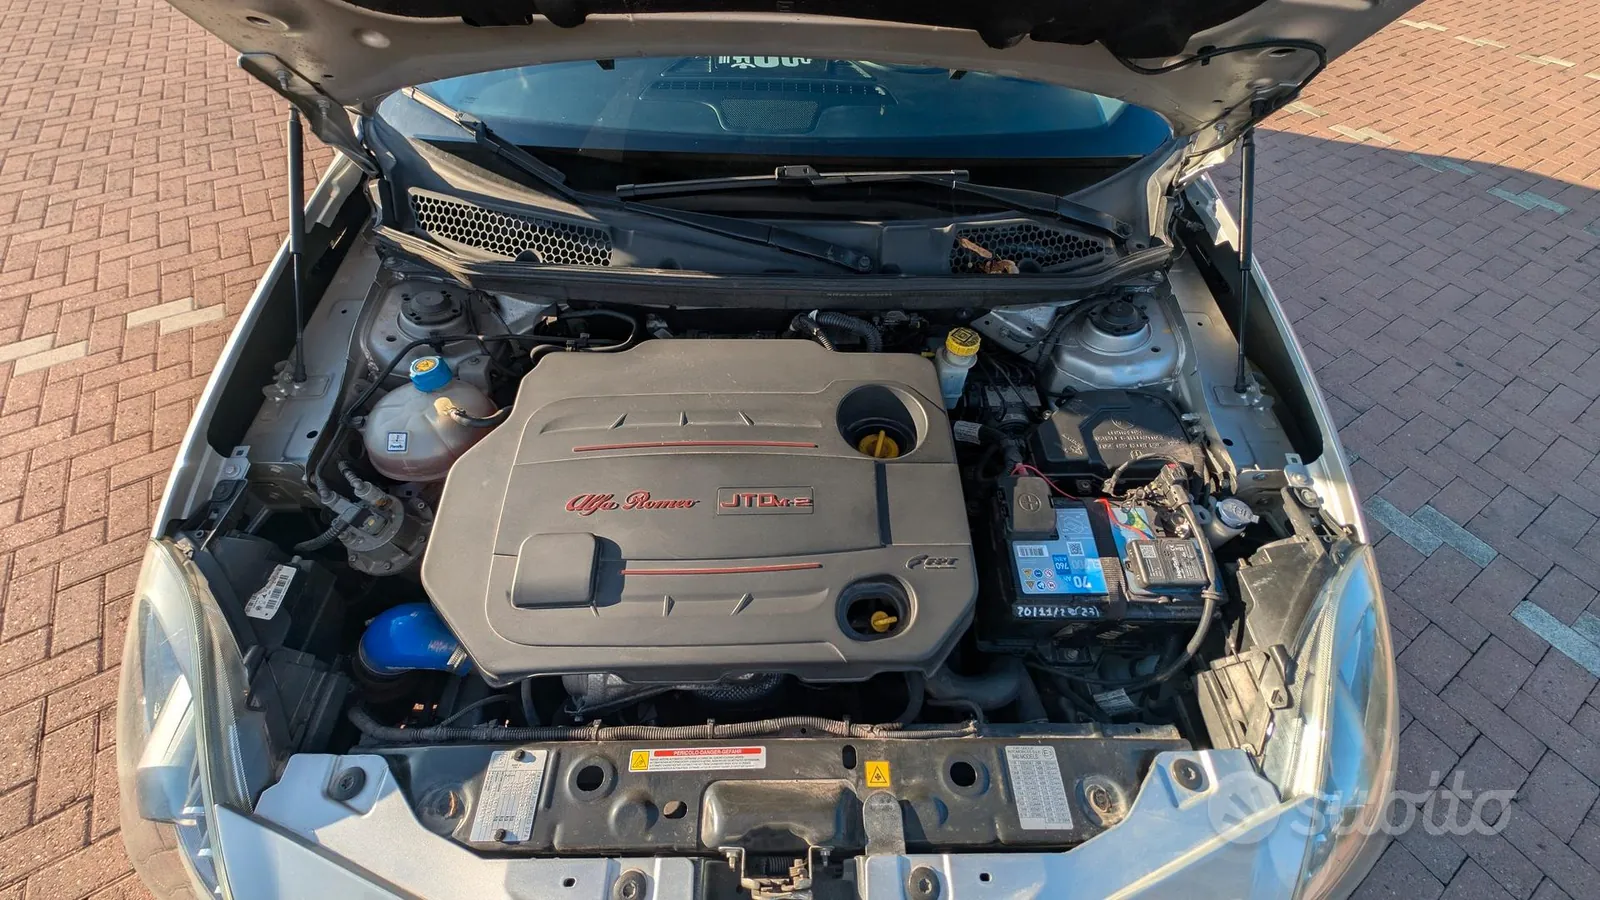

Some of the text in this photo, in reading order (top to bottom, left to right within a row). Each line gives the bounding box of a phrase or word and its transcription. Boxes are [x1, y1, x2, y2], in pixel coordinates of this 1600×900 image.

[565, 489, 700, 517] Alfa Romeo
[1055, 562, 1069, 570] 760
[1073, 575, 1092, 589] 70
